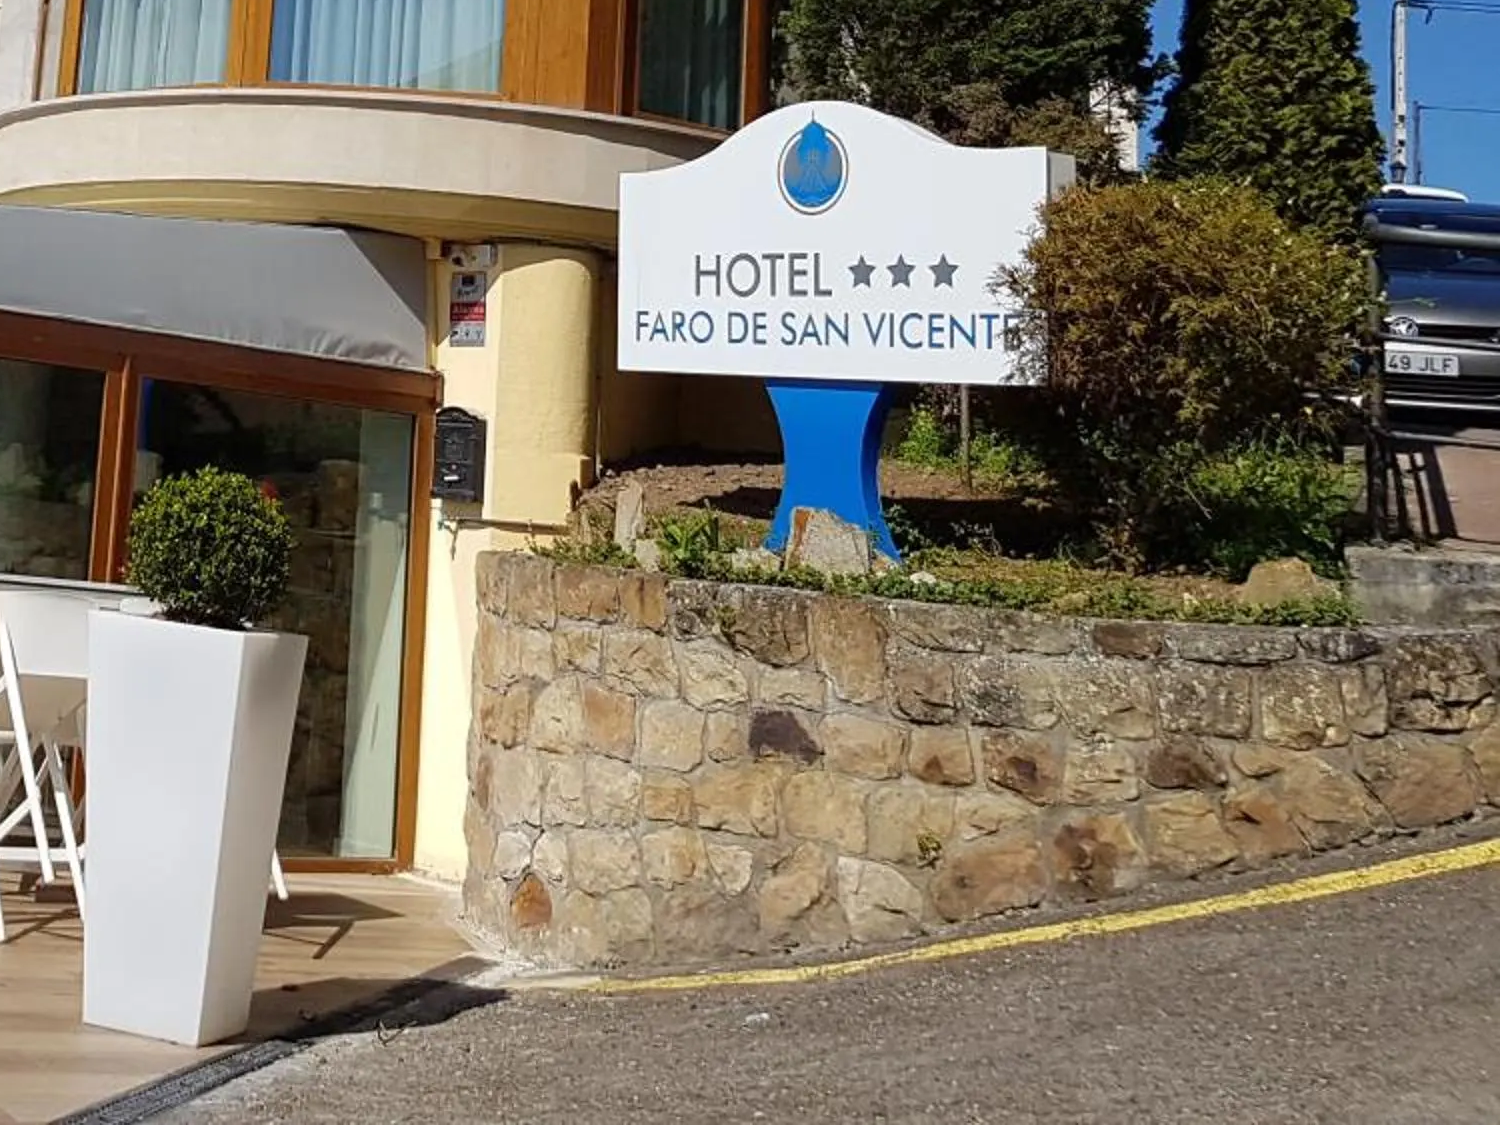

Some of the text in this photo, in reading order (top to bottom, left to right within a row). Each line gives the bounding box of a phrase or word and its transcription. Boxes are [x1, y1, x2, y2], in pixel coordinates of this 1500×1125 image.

[694, 251, 834, 298] HOTEL
[634, 309, 715, 345] FARO
[726, 311, 767, 346] DE
[779, 311, 850, 347] SAN
[1416, 356, 1455, 374] JLF
